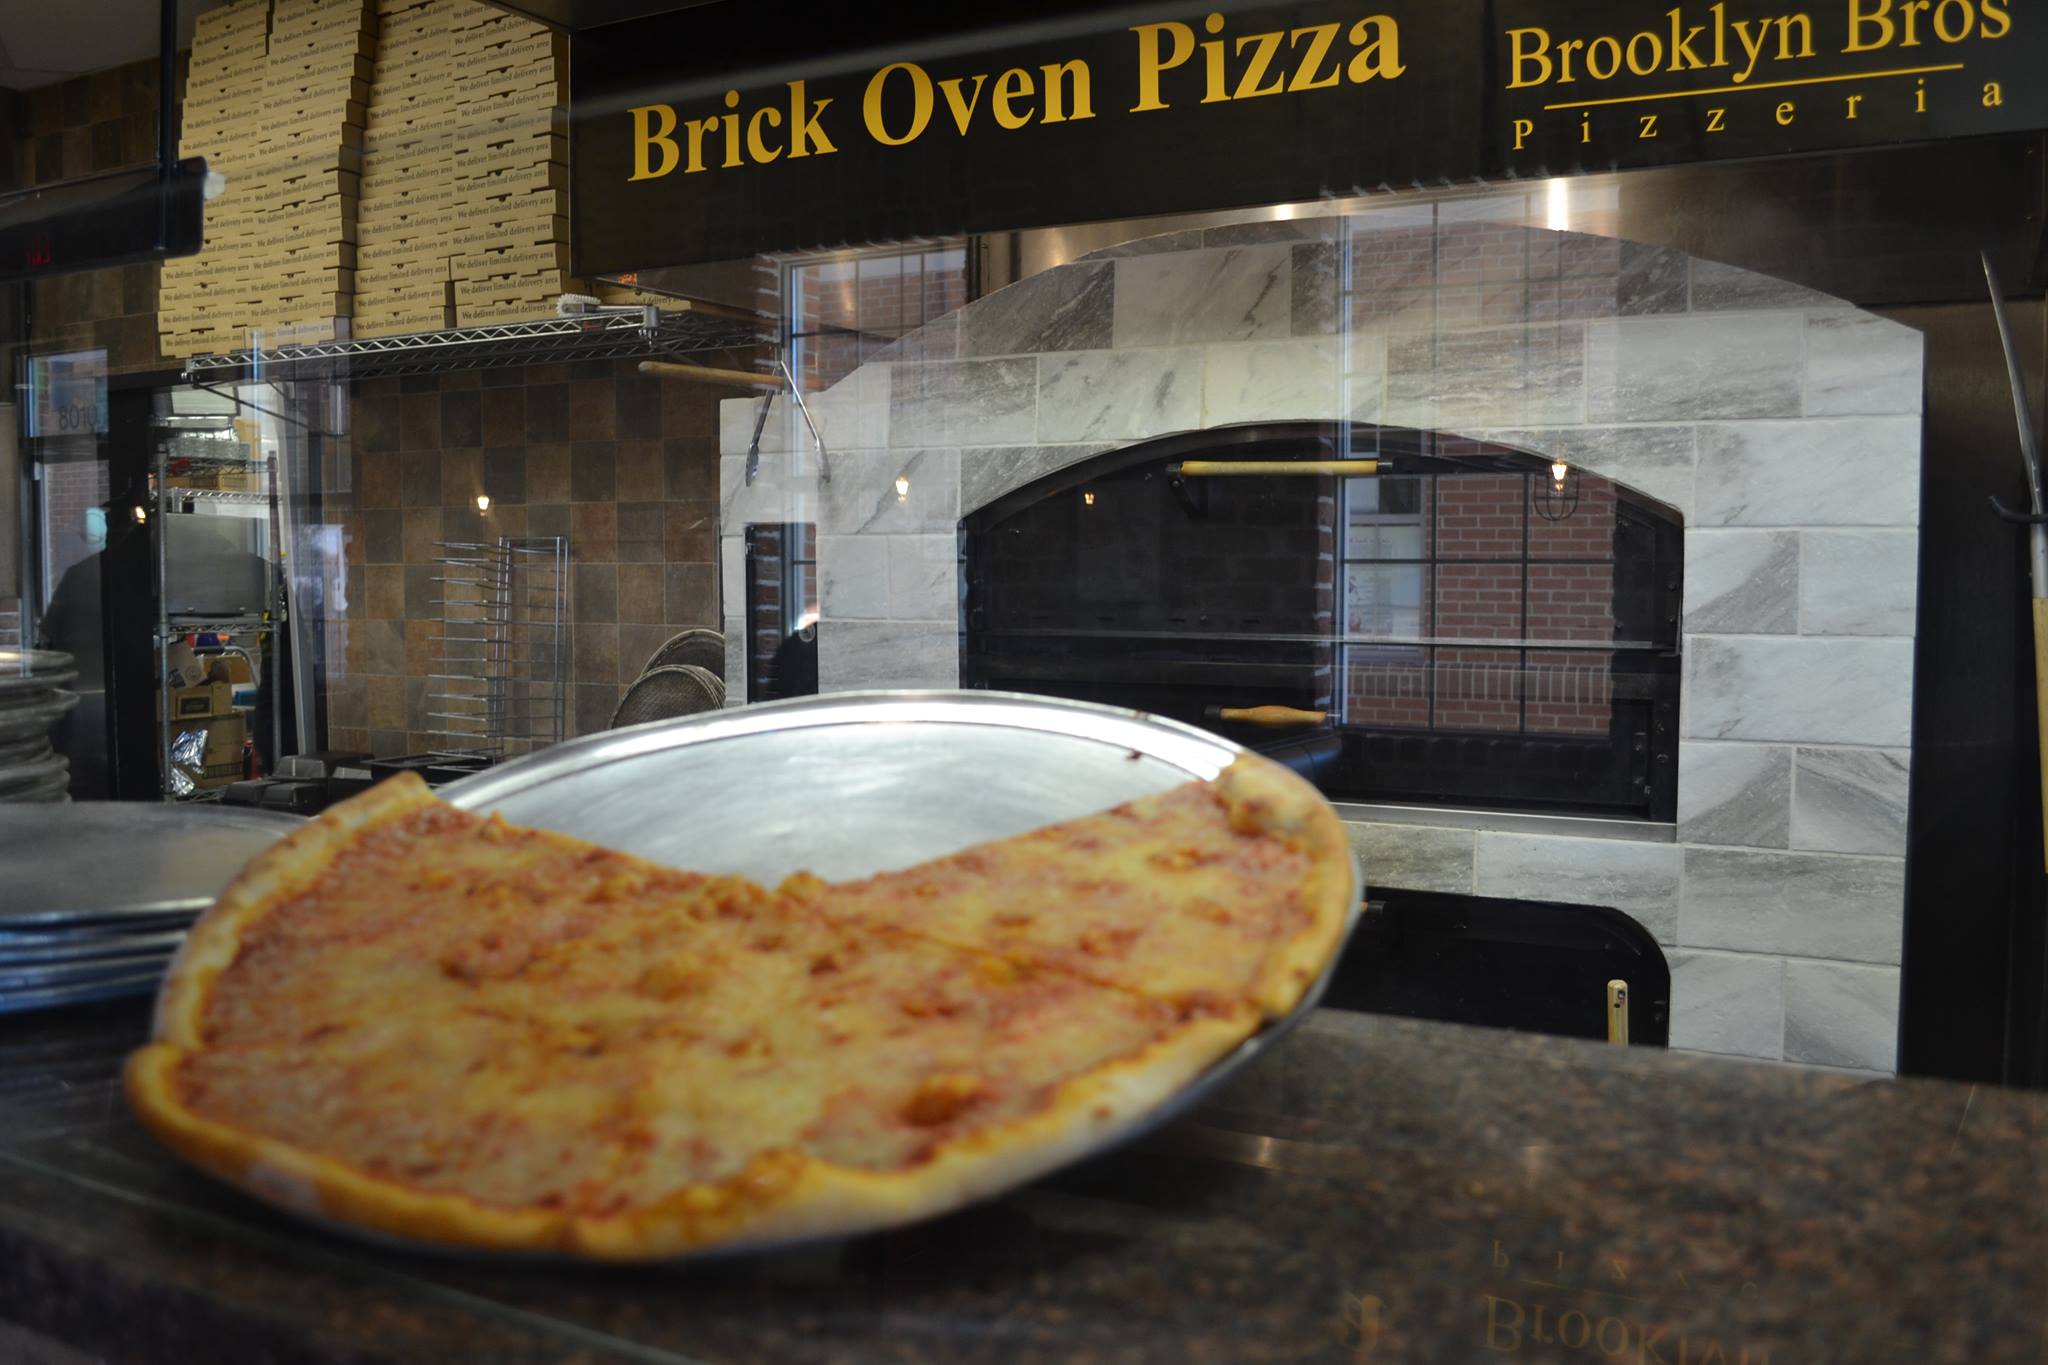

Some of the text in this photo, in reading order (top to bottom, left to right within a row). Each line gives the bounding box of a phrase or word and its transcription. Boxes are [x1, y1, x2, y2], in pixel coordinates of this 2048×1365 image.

[1505, 0, 2012, 88] Brooklyn Bros
[629, 13, 1406, 182] Brick Oven Pizza
[1513, 78, 2003, 150] Pizzeria
